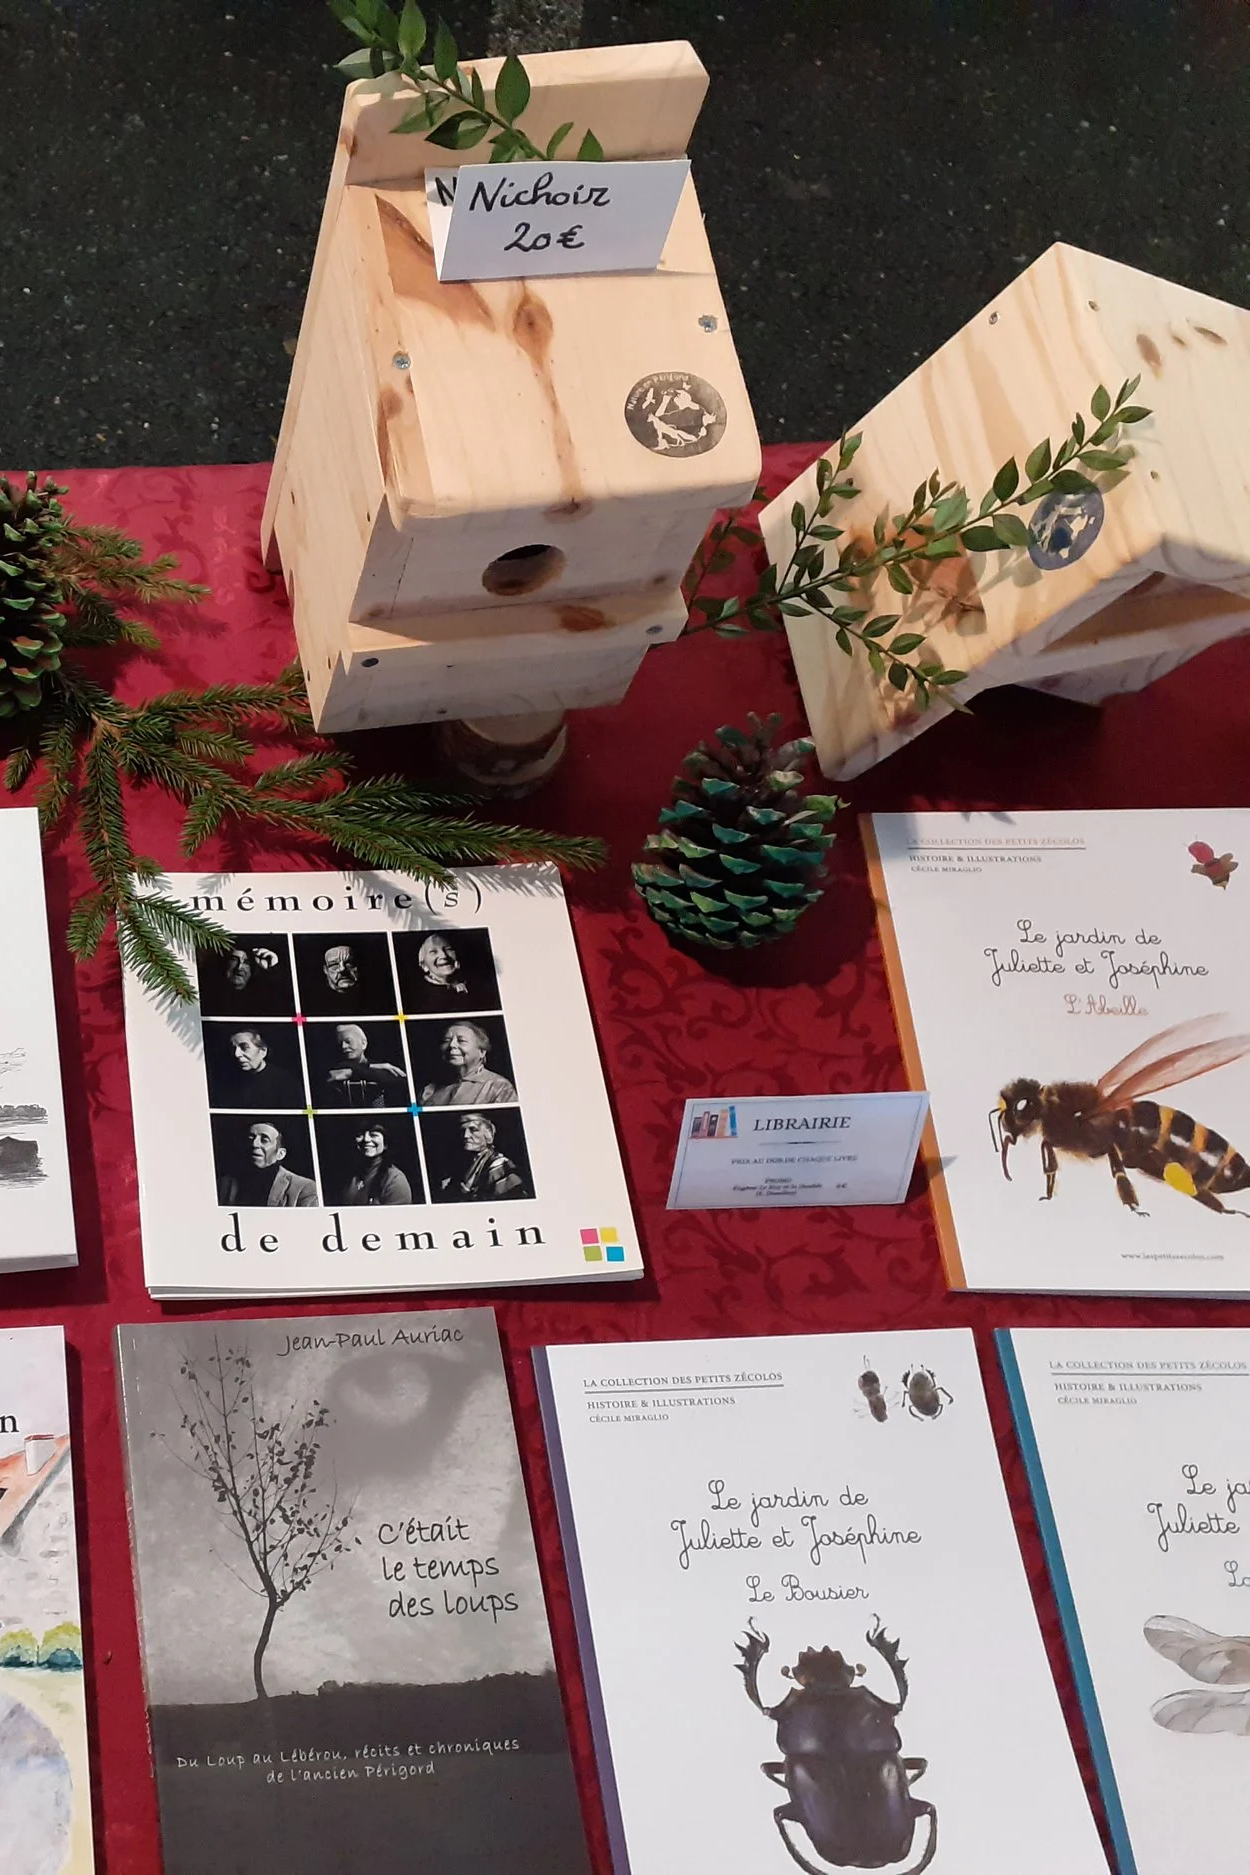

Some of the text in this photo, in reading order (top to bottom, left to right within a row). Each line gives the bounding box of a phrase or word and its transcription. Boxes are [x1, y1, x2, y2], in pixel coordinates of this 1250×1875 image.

[468, 171, 611, 212] Nichoir
[909, 855, 1042, 863] HISTOIRE & ILLUSTRATIONS
[1017, 919, 1162, 958] Le jardin de
[983, 947, 1210, 989] Juliette et Joséphine
[1064, 994, 1149, 1016] L'Abeille
[753, 1116, 852, 1132] LIBRAIRIE
[220, 1212, 547, 1254] de demain
[277, 1325, 464, 1357] Jean-Paul Auriac
[583, 1370, 783, 1388] LA COLLECTION DES PETITS ZÉCOLOS
[1049, 1360, 1247, 1370] LA COLLECTION DES PETITS ZÉCOLOS
[1055, 1383, 1203, 1392] HISTOIRE & ILLUSTRATIONS
[1058, 1396, 1138, 1405] CÉCILE MIRAGLIO
[587, 1396, 736, 1410] HISTOIRE & ILLUSTRATIONS
[589, 1412, 669, 1424] CÉCILE MIRAGLIO
[1182, 1464, 1217, 1495] Le
[707, 1479, 869, 1528] Le jardin de
[378, 1517, 470, 1546] C'était
[670, 1514, 922, 1570] Juliette et Joséphine
[1146, 1502, 1241, 1552] Juliette
[383, 1554, 501, 1588] le temps
[746, 1573, 869, 1602] Le Bousier
[388, 1589, 519, 1624] des loups
[177, 1738, 520, 1771] Du Loup au Lébérou, récits et chroniques
[266, 1762, 436, 1784] de l'ancien Périgord
